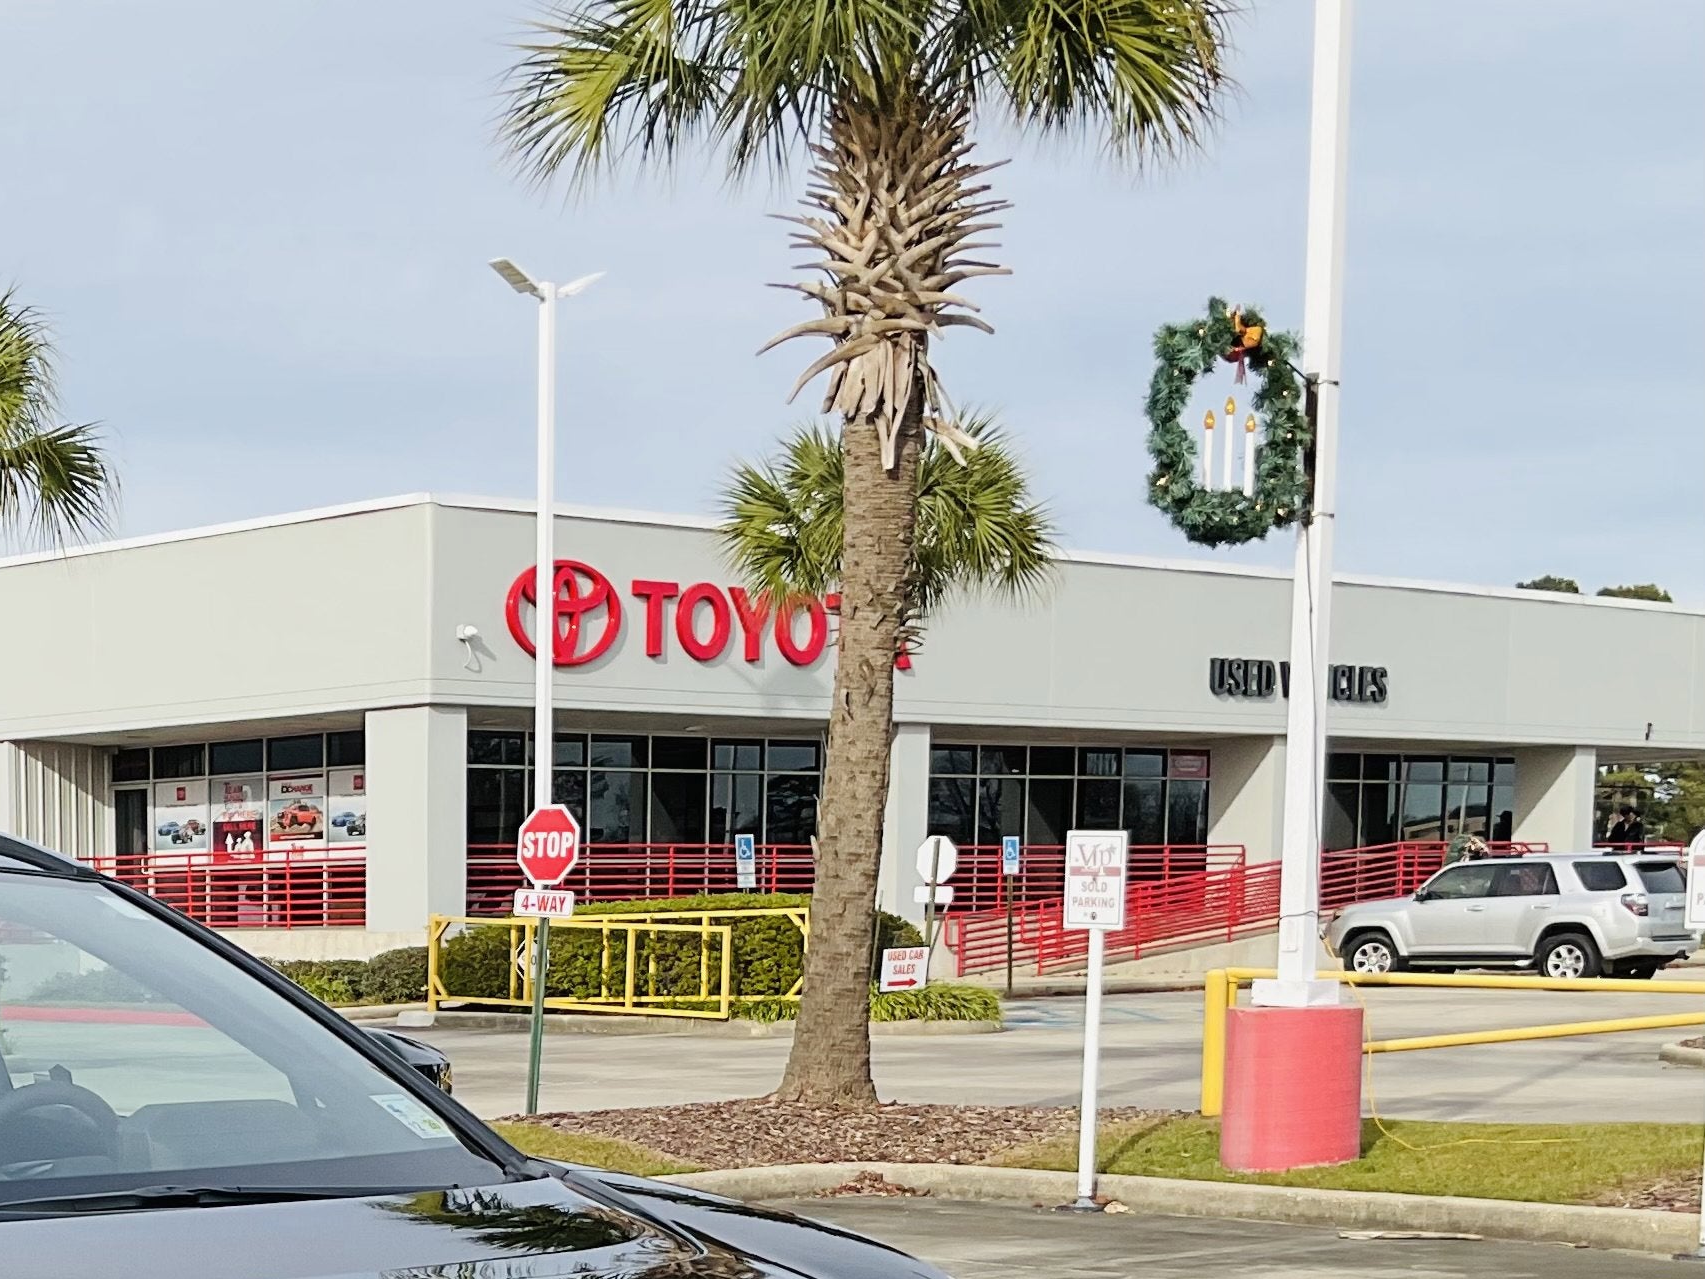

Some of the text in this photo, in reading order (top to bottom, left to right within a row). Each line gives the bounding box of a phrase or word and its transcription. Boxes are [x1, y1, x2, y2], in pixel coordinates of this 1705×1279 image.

[631, 578, 913, 671] TOYO
[1209, 657, 1276, 698] USED
[522, 831, 574, 859] STOP
[1081, 881, 1107, 893] SOLD
[521, 894, 566, 913] 4-WAY
[1072, 896, 1115, 908] PARKING
[887, 950, 907, 961] USED
[893, 964, 916, 975] SALES
